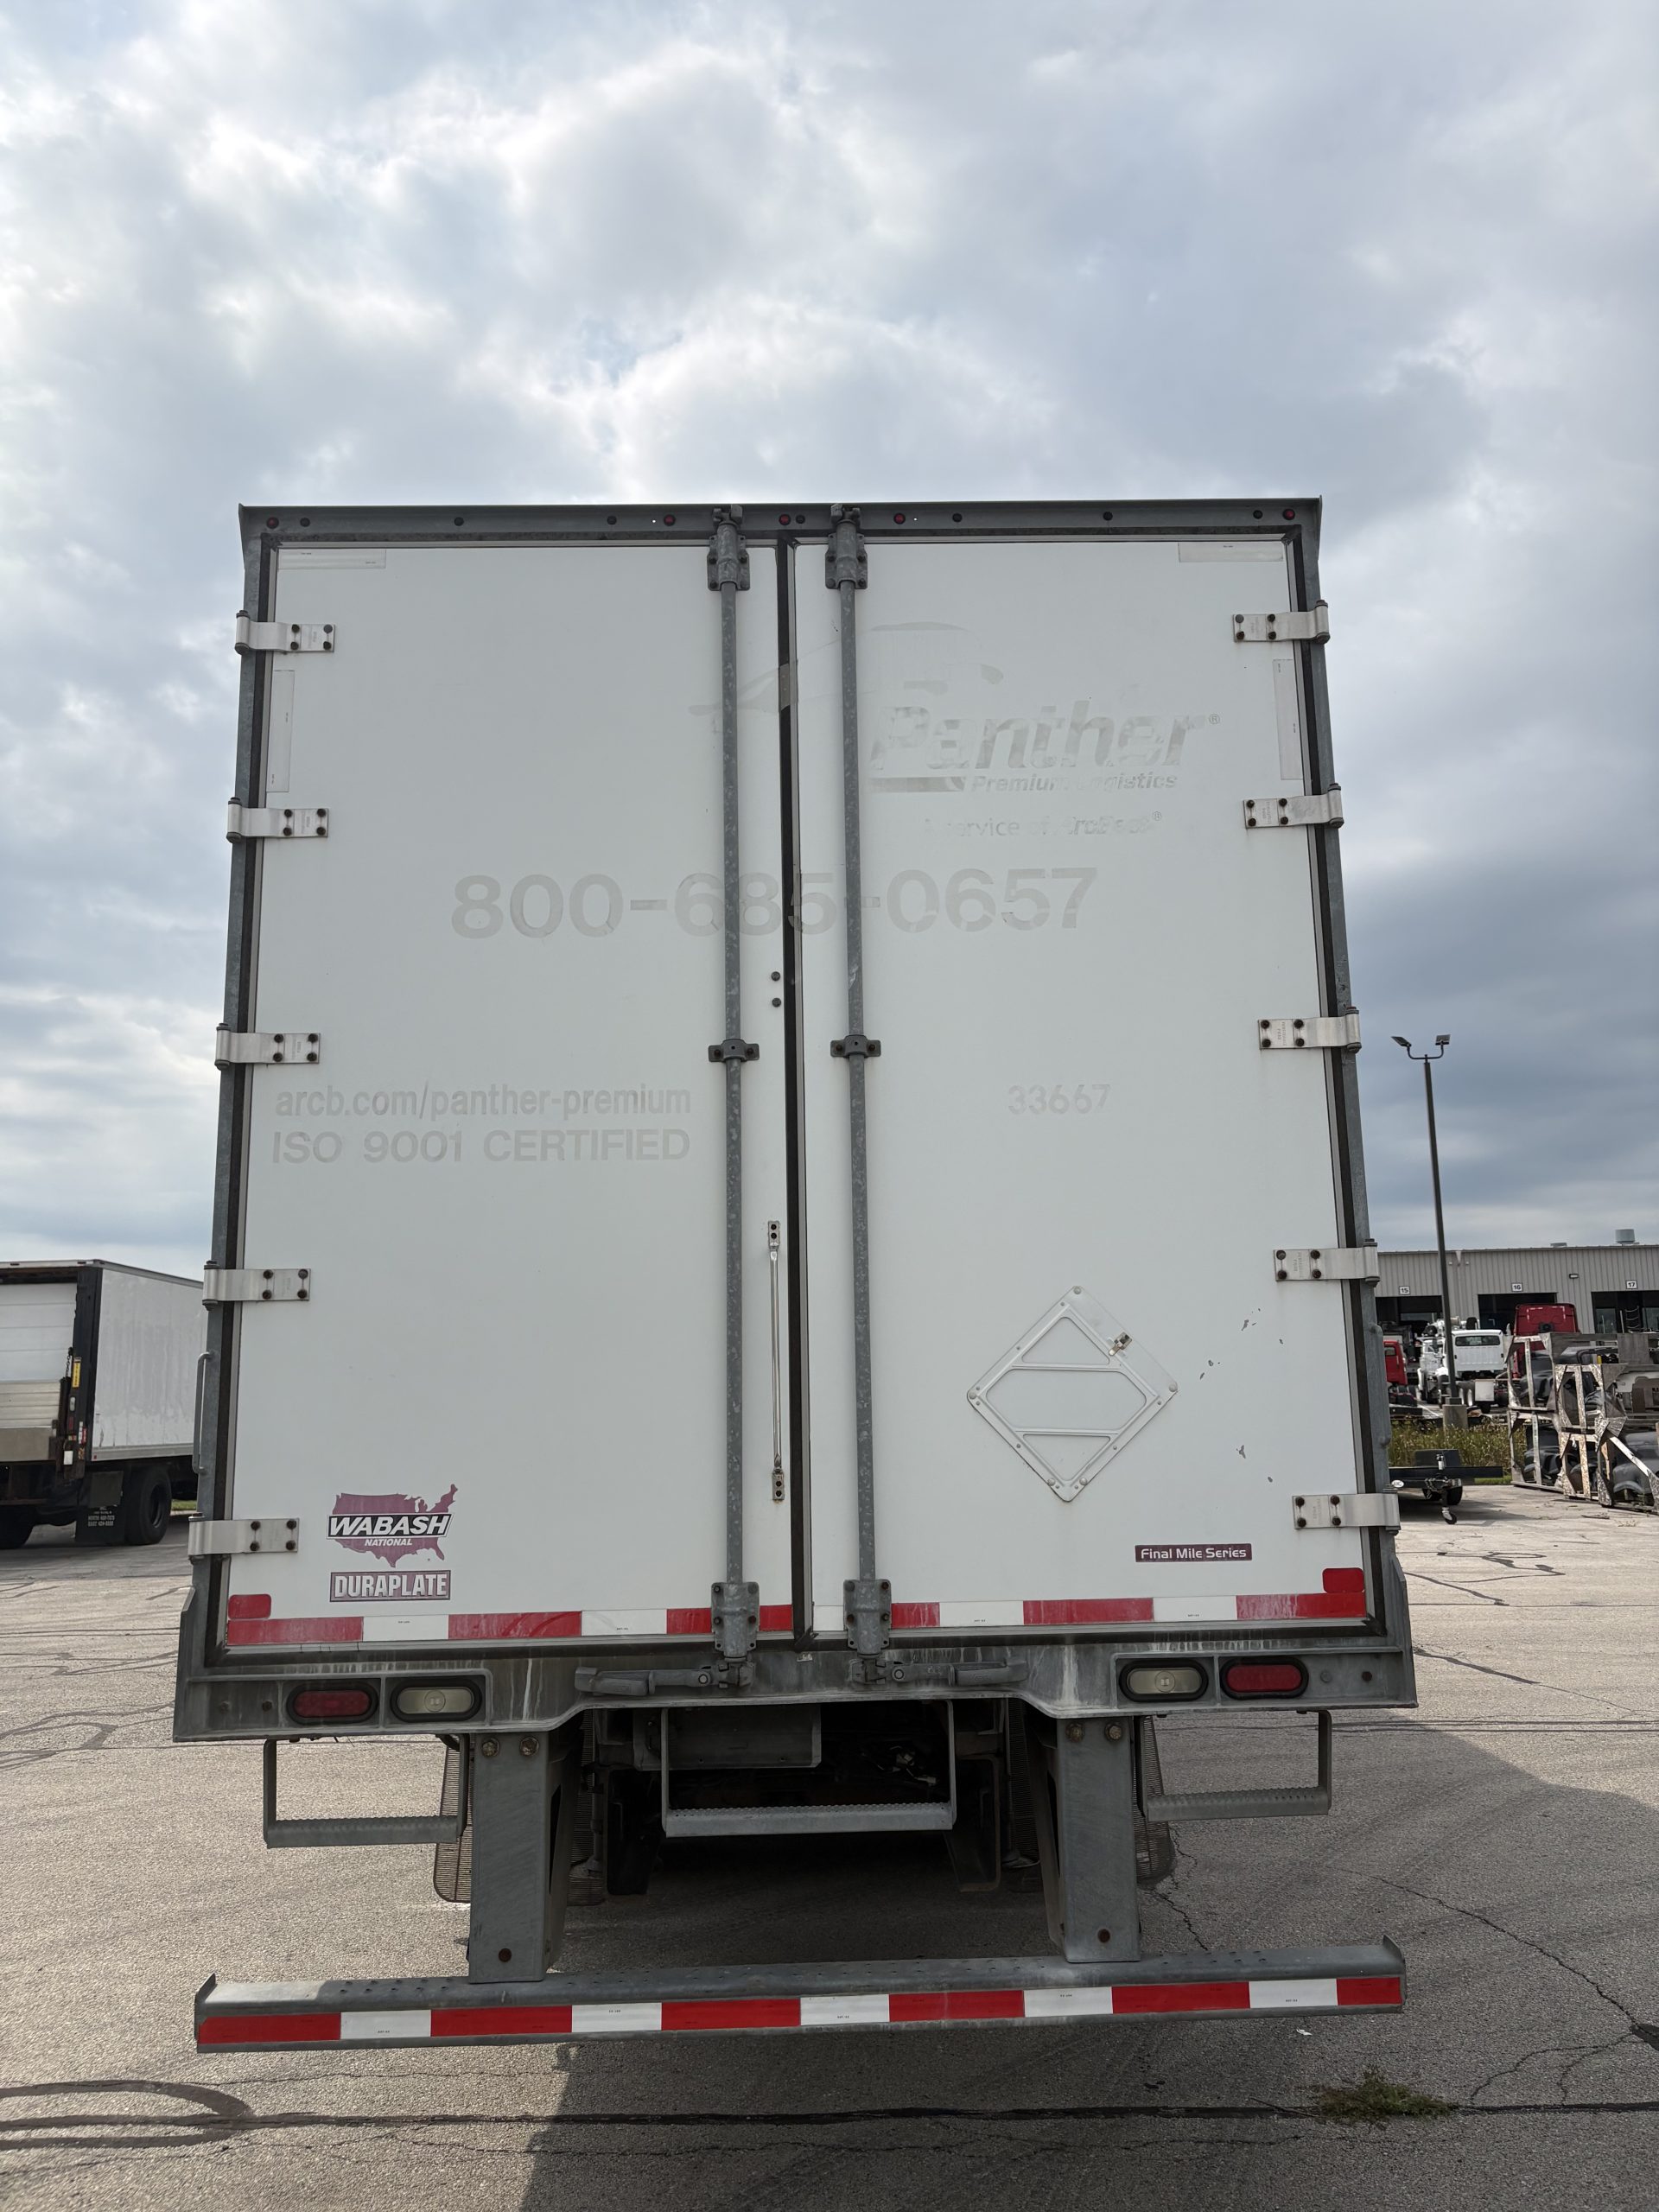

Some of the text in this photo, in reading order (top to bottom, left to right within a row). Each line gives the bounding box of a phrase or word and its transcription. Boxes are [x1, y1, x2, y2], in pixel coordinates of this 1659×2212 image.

[1077, 772, 1179, 793] ogistics
[450, 867, 1098, 939] 800-685-0657
[274, 1080, 692, 1121] arcb.com/panther-premium
[1007, 1084, 1111, 1115] 33667
[272, 1128, 690, 1164] ISO 9001 CERTIFIED
[329, 1516, 450, 1536] WABASH
[365, 1538, 413, 1547] NATIONAL
[1141, 1547, 1247, 1559] Final Mile Series
[334, 1573, 448, 1598] DURAPLATE
